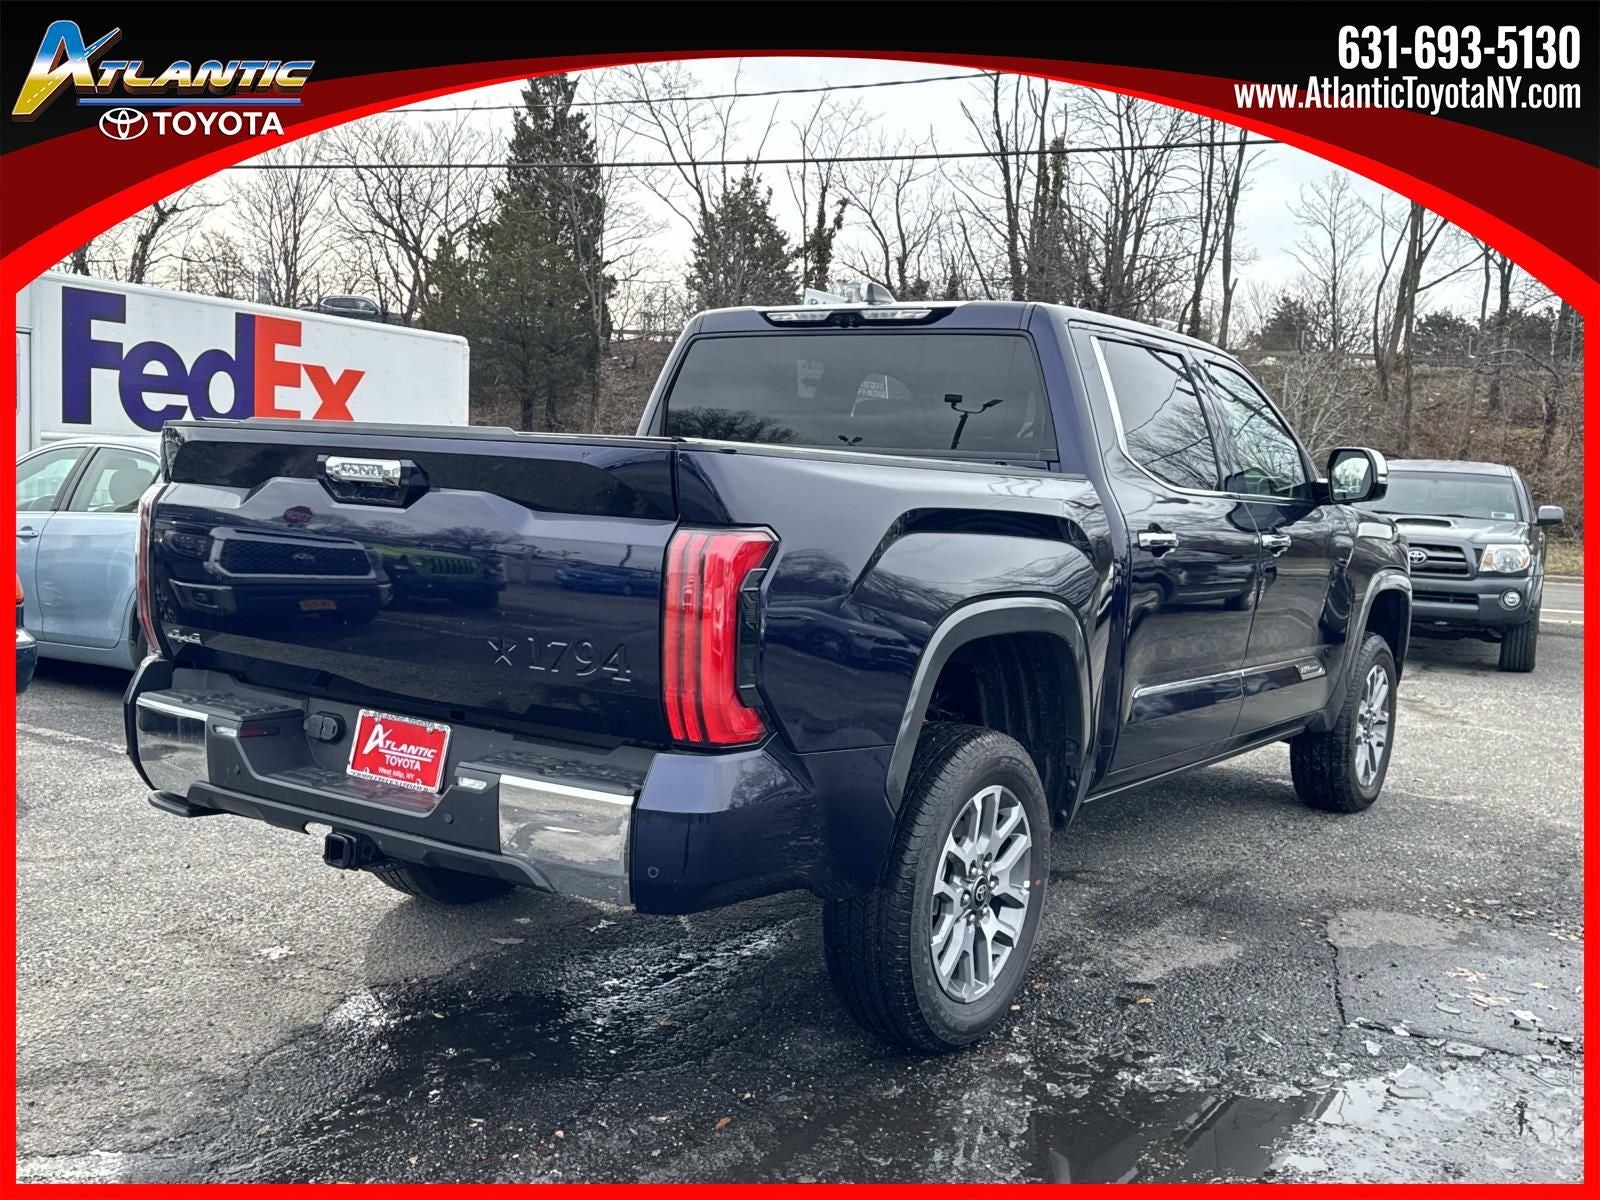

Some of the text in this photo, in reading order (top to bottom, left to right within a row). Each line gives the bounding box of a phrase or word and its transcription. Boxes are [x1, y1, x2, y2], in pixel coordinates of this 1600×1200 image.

[62, 286, 366, 432] FedEx
[527, 636, 632, 683] 1794
[362, 723, 437, 758] ATLANTIC
[385, 754, 421, 771] TOYOTA
